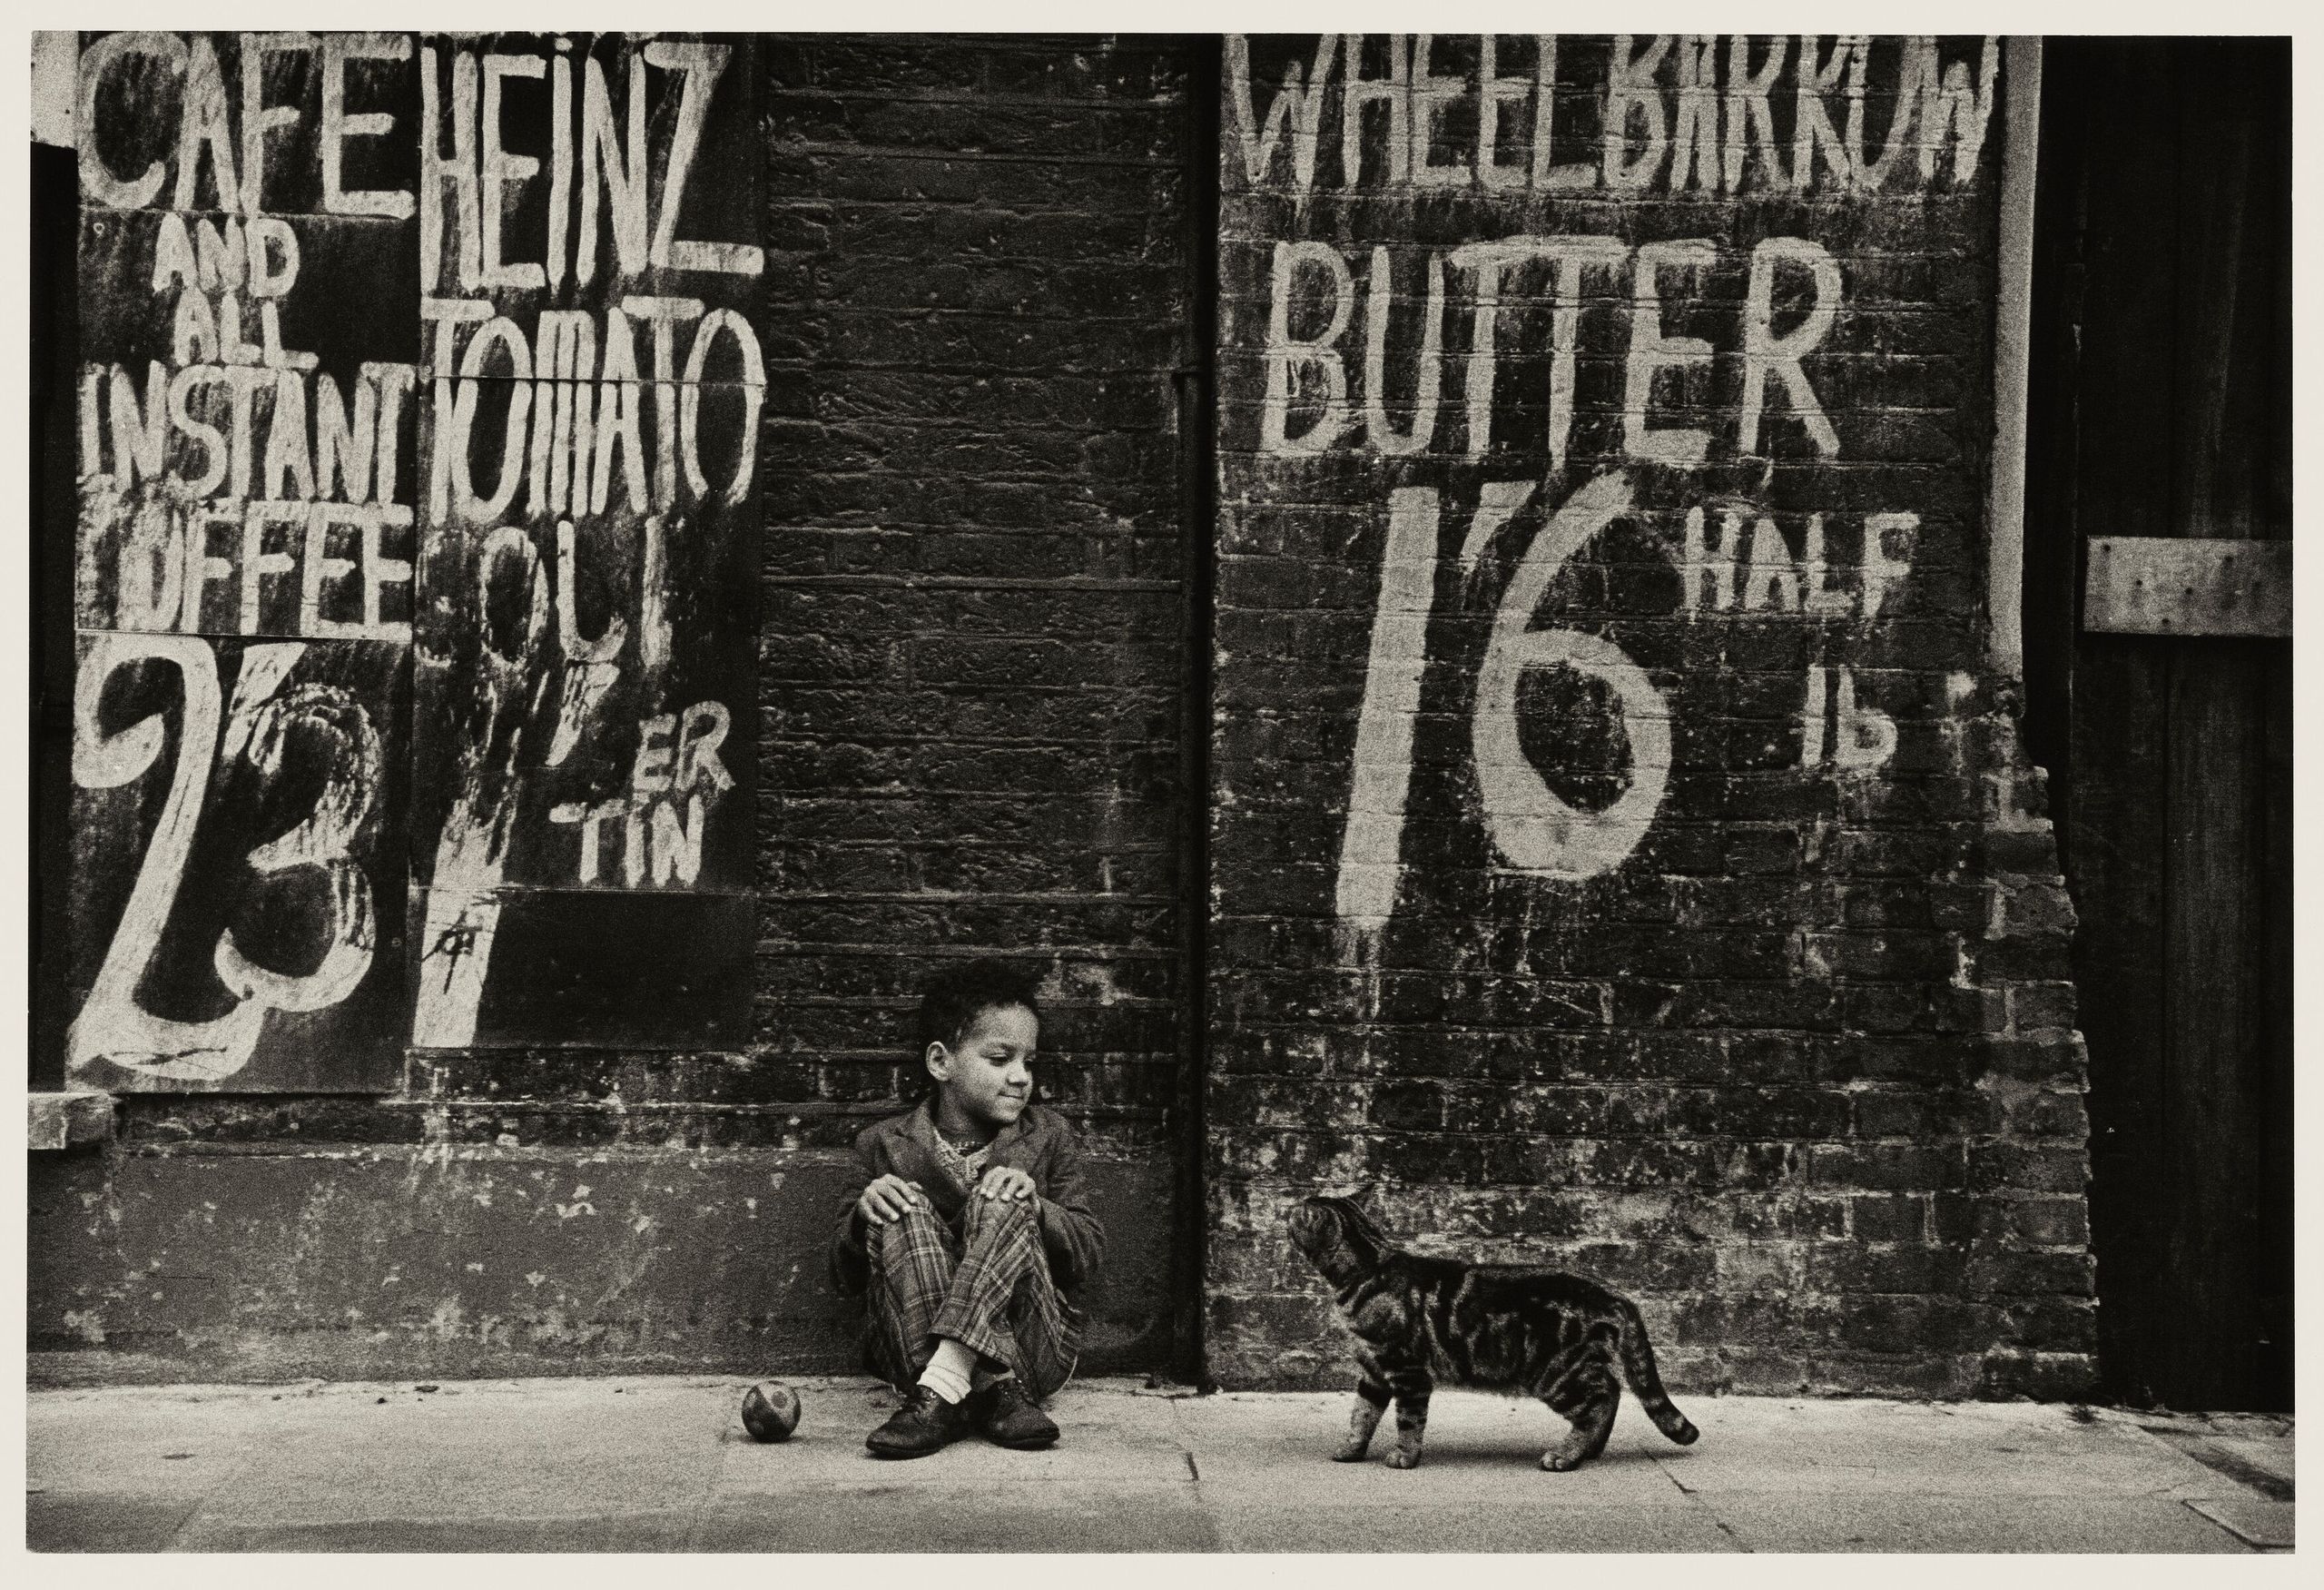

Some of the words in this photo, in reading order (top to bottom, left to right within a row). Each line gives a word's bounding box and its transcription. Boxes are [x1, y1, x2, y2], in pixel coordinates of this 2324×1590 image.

[78, 31, 417, 221] CAFE
[153, 212, 300, 297] AND
[174, 287, 320, 369] ALL
[1262, 234, 1843, 472] BUTTER
[76, 360, 415, 505] INSTANT
[420, 295, 766, 527] TOMATO
[1681, 504, 1921, 627] HALF
[548, 793, 705, 888] TIN
